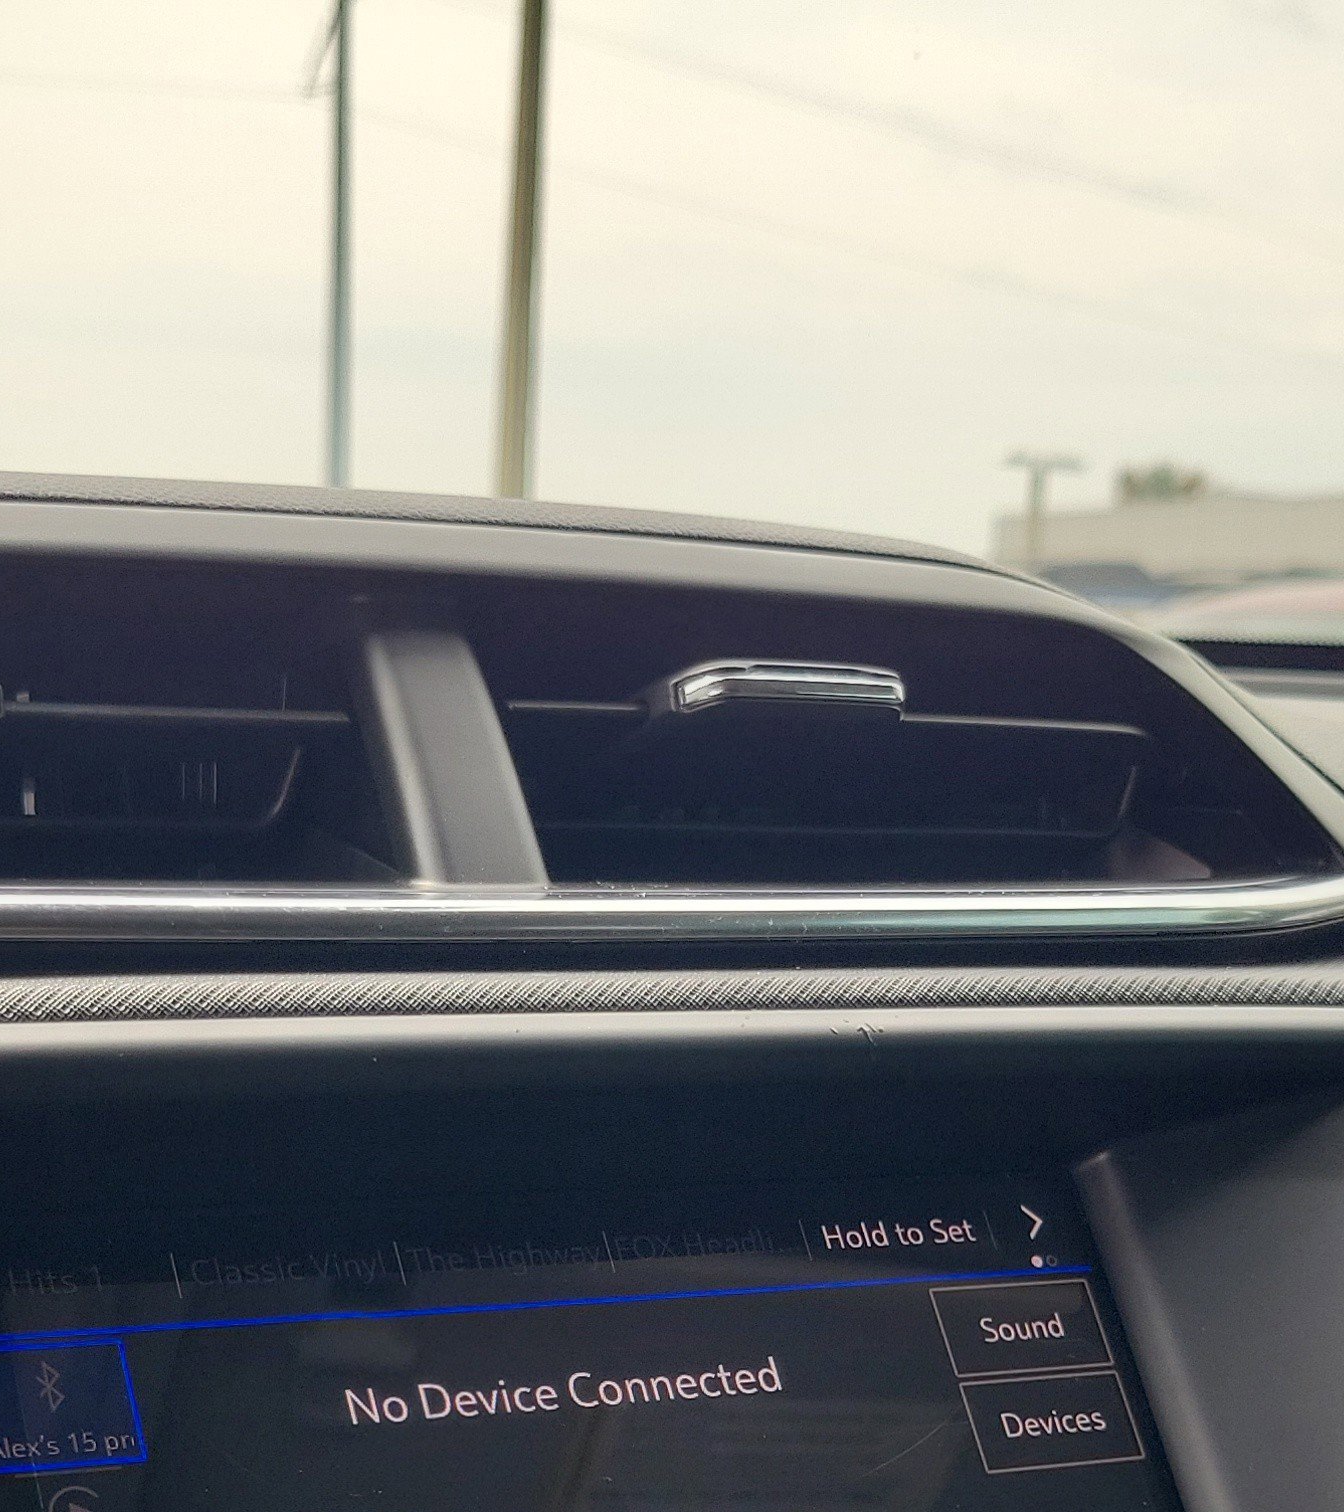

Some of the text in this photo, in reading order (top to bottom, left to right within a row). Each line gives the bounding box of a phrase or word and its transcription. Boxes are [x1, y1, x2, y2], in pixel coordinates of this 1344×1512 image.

[821, 1217, 977, 1250] Hold to Set
[189, 1249, 387, 1287] Classic Vinyl
[404, 1240, 601, 1277] The Highway
[978, 1312, 1065, 1344] Sound
[343, 1355, 783, 1426] No Device Connected
[1000, 1409, 1107, 1439] Devices
[67, 1431, 97, 1454] 15
